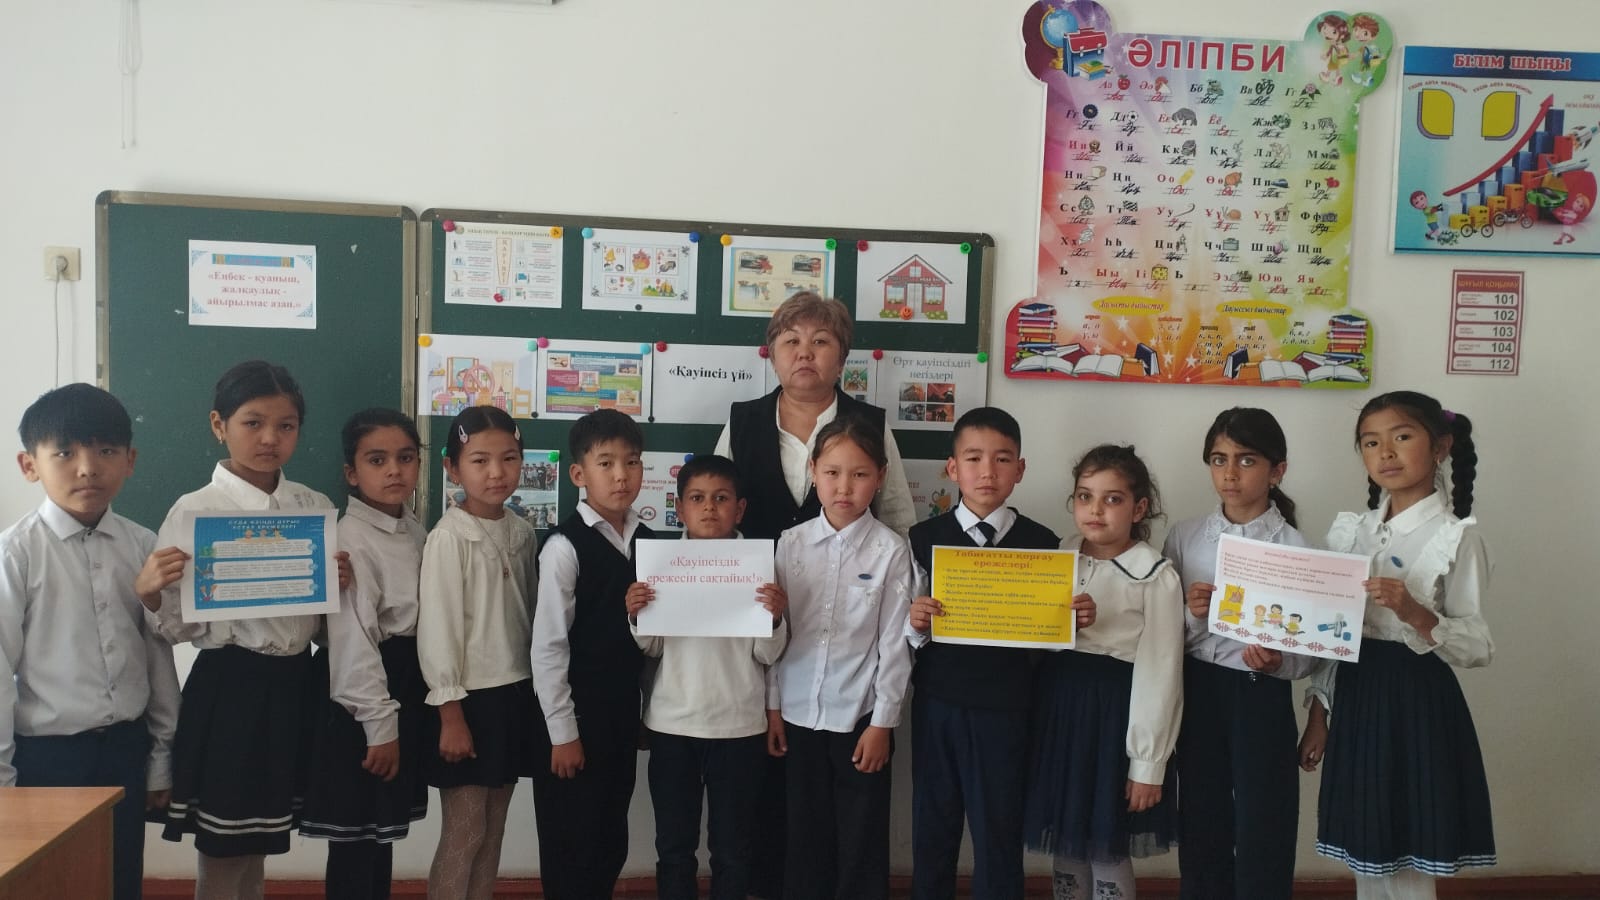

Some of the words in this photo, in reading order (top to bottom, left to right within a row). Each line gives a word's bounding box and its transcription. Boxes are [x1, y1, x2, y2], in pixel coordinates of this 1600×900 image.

[1127, 40, 1284, 72] ӘЛІПБИ
[1454, 54, 1504, 68] БІЛІМ
[1510, 56, 1571, 71] ШЫҢЫ
[1494, 294, 1514, 305] 101
[1494, 310, 1514, 321] 102
[1493, 326, 1513, 337] 103
[1491, 342, 1512, 353] 104
[893, 356, 912, 370] Өрт
[1490, 358, 1510, 369] 112
[669, 365, 727, 381] «Қауіпсіз
[731, 369, 753, 384] үй»
[909, 370, 954, 381] негіздері
[670, 556, 740, 568] «Қауіпсіздік
[647, 572, 697, 585] ережесін
